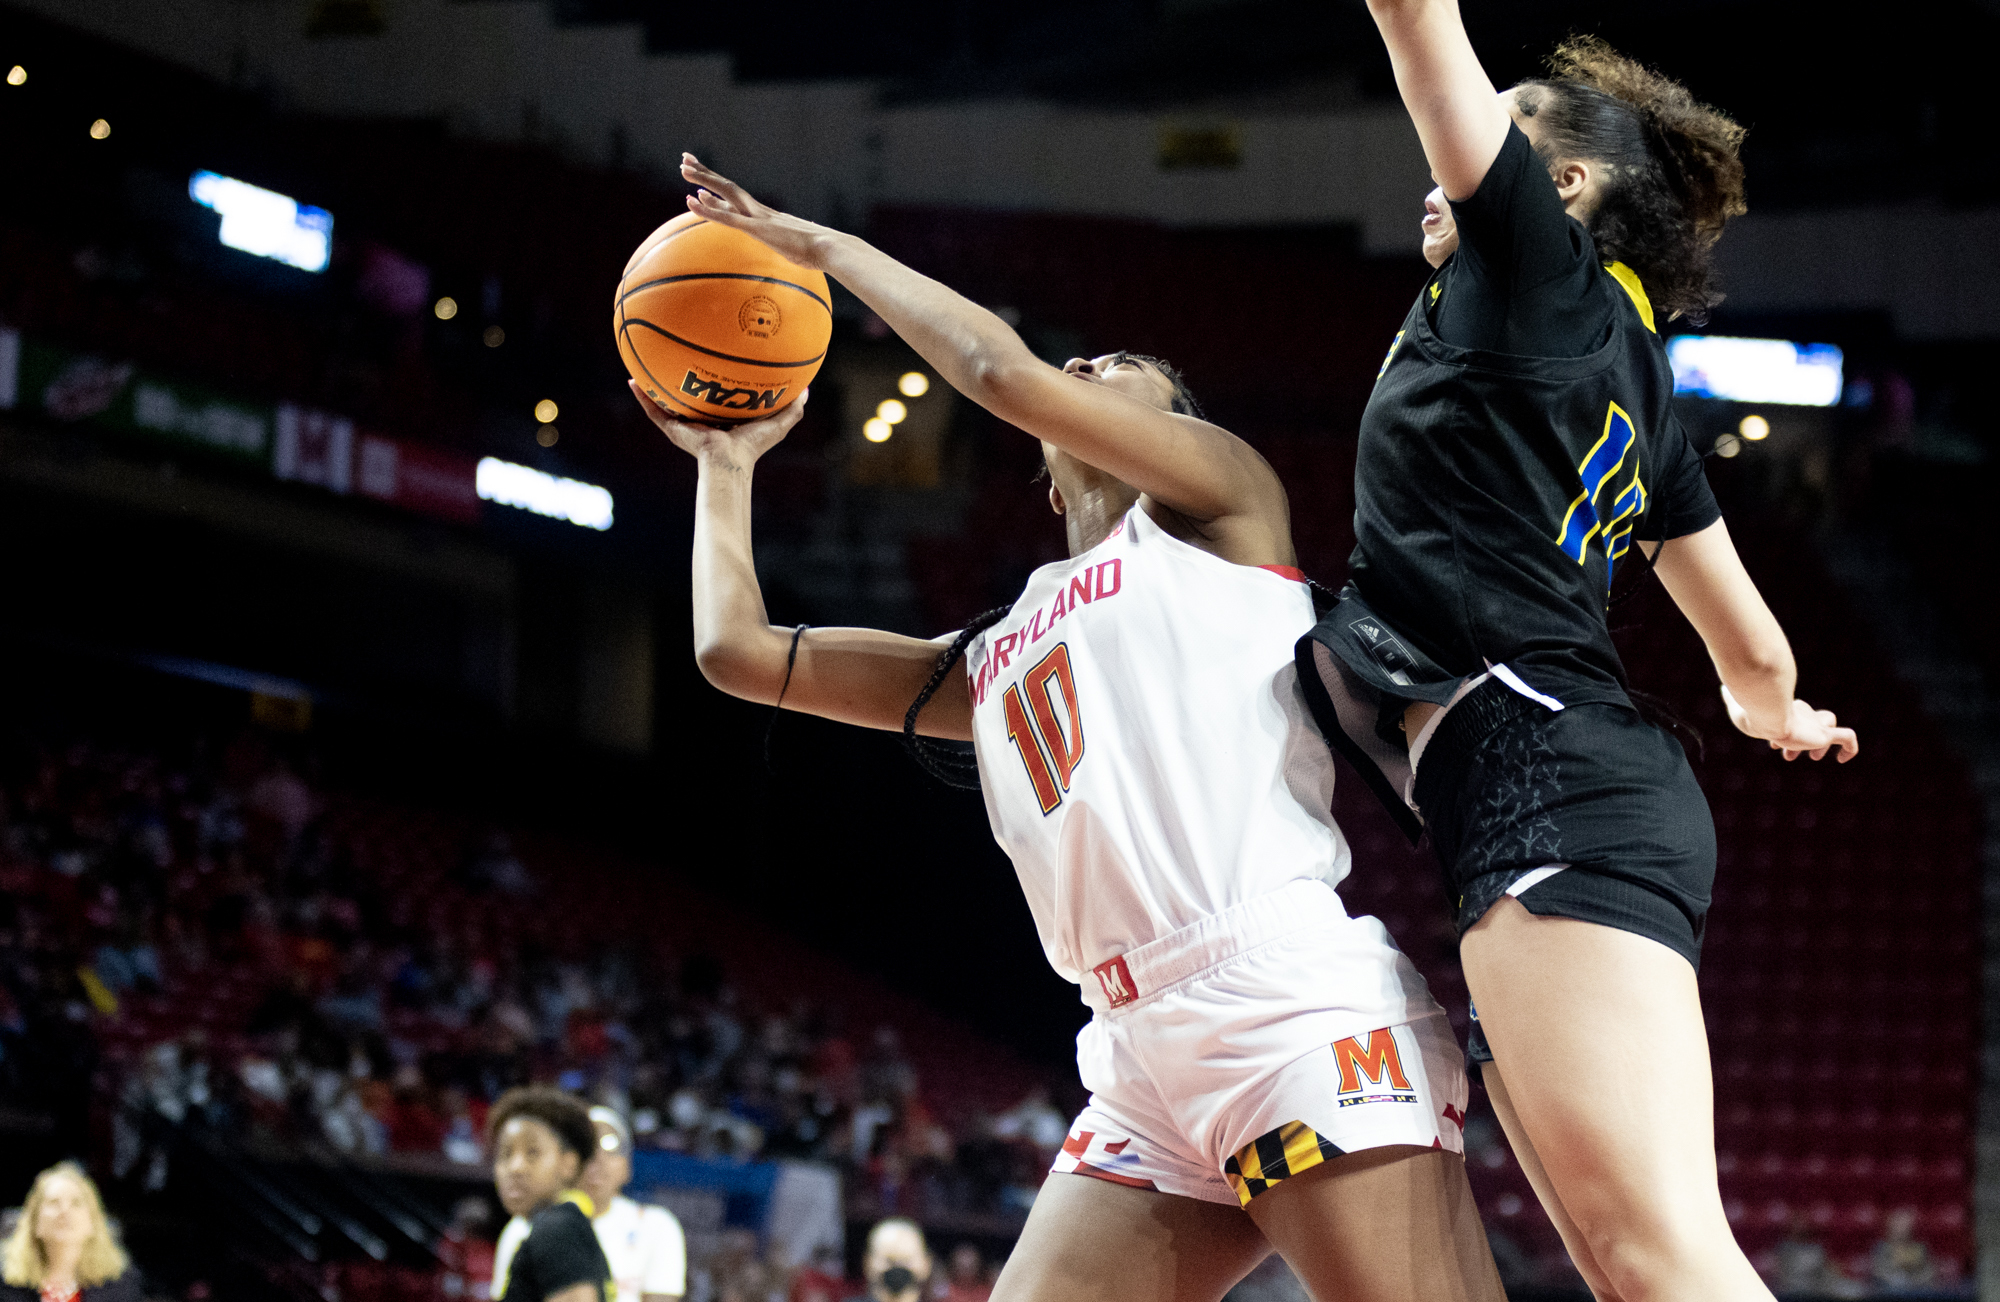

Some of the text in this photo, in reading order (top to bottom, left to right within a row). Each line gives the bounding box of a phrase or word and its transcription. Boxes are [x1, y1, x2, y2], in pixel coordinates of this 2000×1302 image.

[680, 368, 790, 411] NCAA
[968, 558, 1122, 720] MARYLAND
[1002, 641, 1085, 817] 10
[1098, 963, 1130, 1002] M
[1330, 1025, 1414, 1096] M
